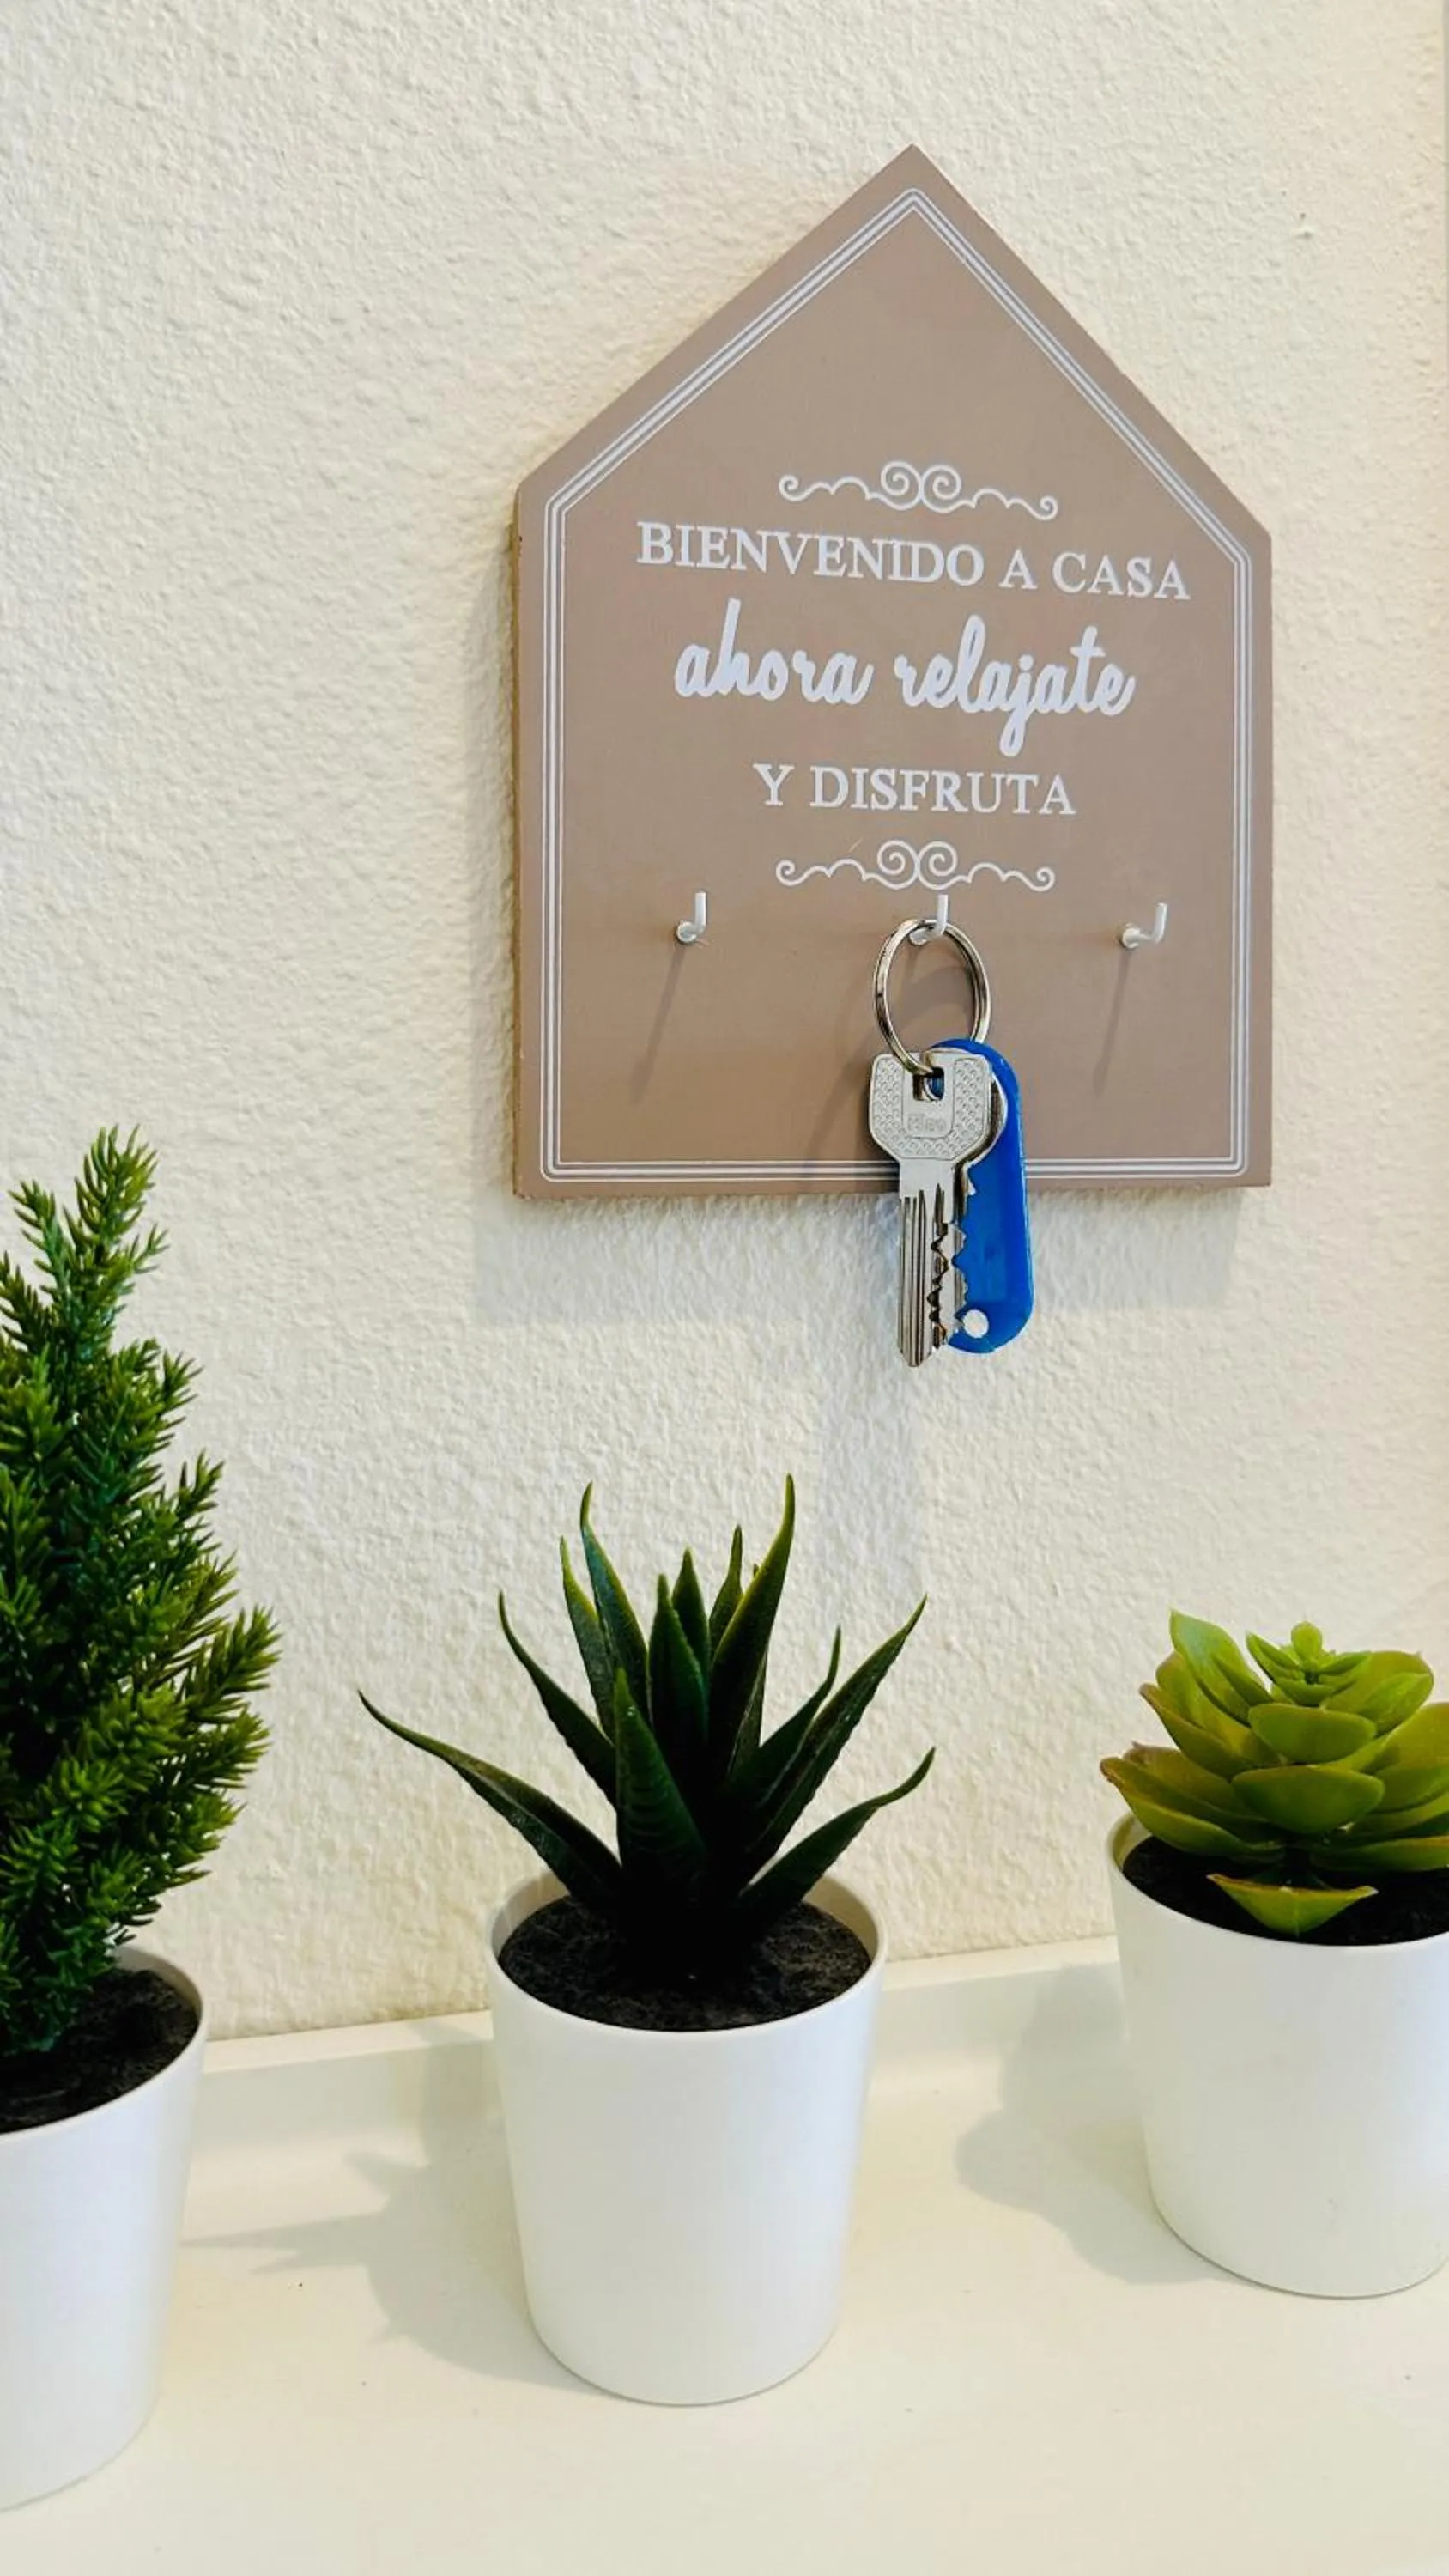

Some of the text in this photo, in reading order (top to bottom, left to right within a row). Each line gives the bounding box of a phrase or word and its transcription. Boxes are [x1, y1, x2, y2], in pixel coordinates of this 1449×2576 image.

[637, 521, 1191, 599] BIENVENIDO A CASA
[675, 597, 1136, 756] ahora relajate
[752, 762, 1076, 815] Y DISFRUTA
